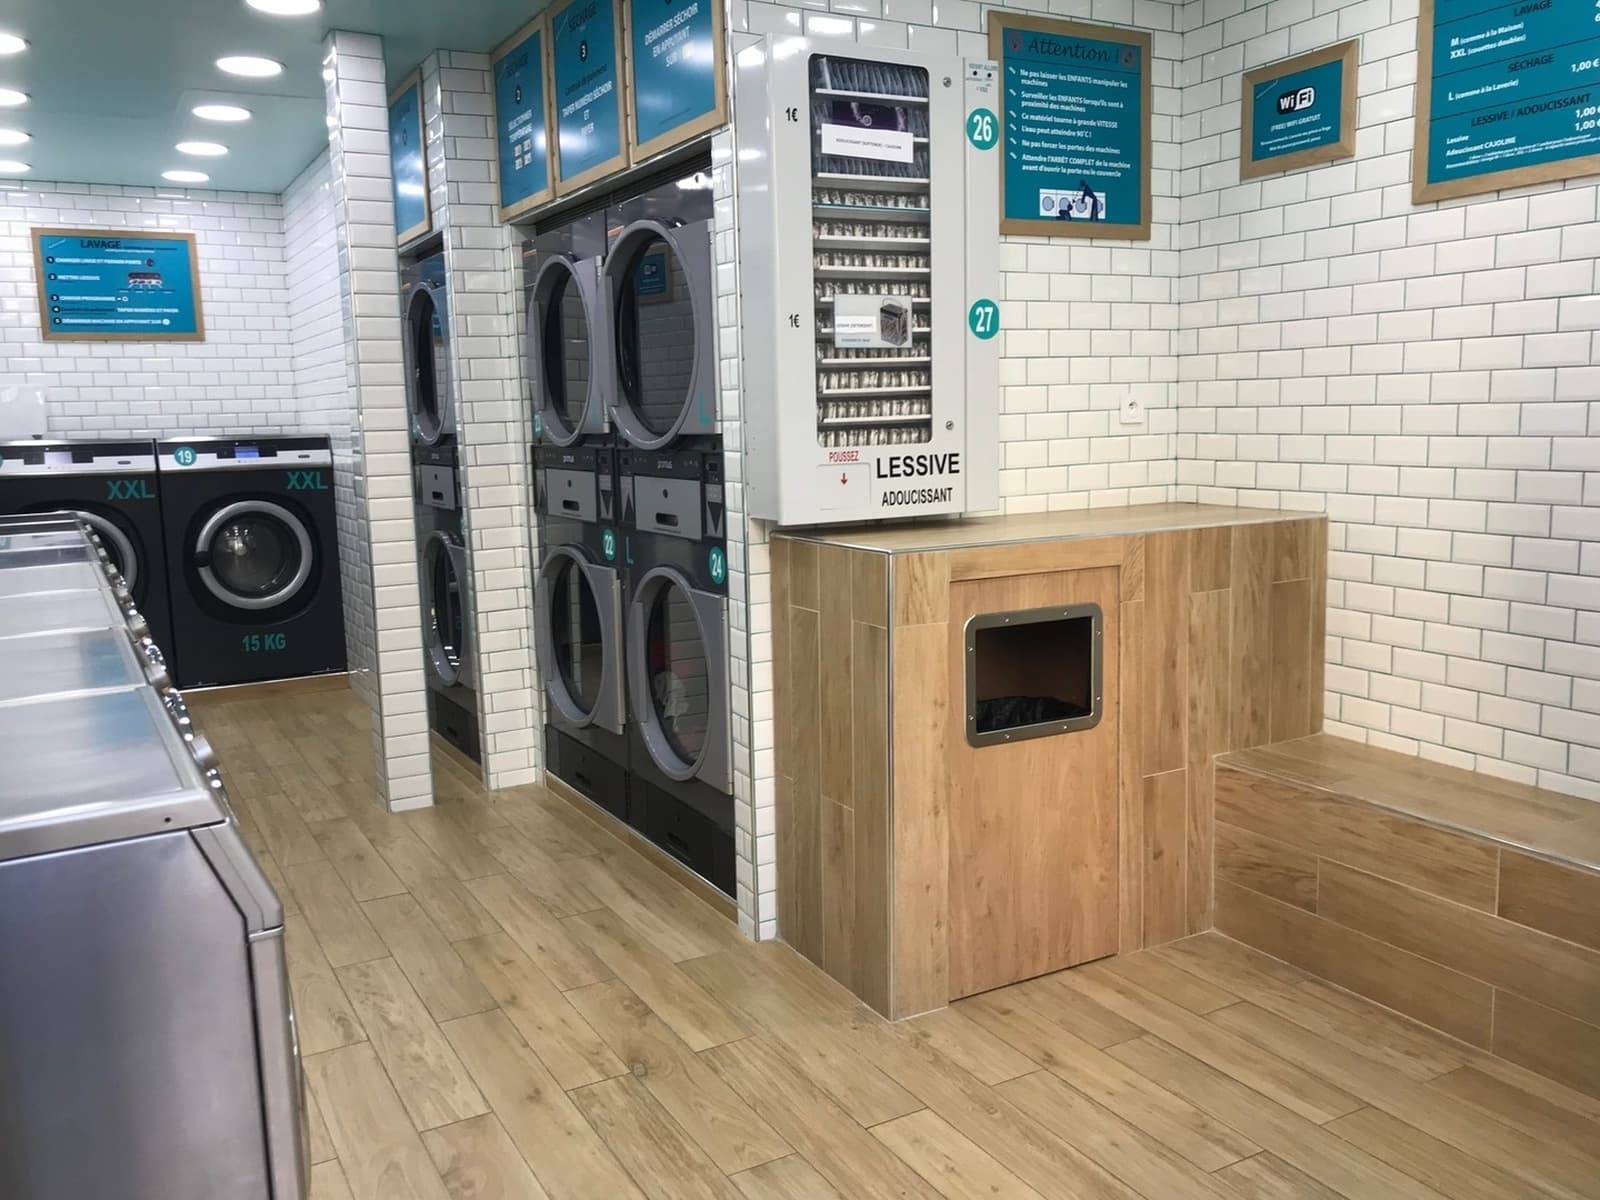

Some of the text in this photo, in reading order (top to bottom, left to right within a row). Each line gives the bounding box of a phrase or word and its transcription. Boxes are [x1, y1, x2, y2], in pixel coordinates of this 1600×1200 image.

[1513, 0, 1553, 17] LAVAGE
[1028, 37, 1110, 61] Attention
[1450, 37, 1459, 47] M
[1449, 48, 1467, 59] XXL
[1508, 53, 1555, 72] SECHAGE
[1570, 60, 1592, 72] 1,00
[1020, 69, 1028, 77] Ne
[1058, 73, 1067, 81] les
[1067, 74, 1093, 84] ENFANTS
[1021, 79, 1048, 87] machines
[1049, 93, 1057, 101] les
[1057, 94, 1083, 104] ENFANTS
[1448, 91, 1454, 101] L
[785, 107, 798, 122] 1€
[1049, 102, 1059, 110] des
[1060, 104, 1086, 112] machines
[1471, 111, 1510, 127] LESSIVE
[1516, 93, 1592, 116] ADOUCISSANT
[1575, 106, 1596, 118] 1,00
[973, 114, 992, 142] 26
[1037, 127, 1050, 135] peut
[1575, 119, 1595, 131] 1,00
[1058, 142, 1067, 150] les
[1069, 157, 1095, 166] COMPLET
[80, 240, 121, 249] LAVAGE
[788, 314, 800, 329] 1€
[975, 306, 993, 332] 27
[177, 450, 192, 464] 19
[829, 450, 859, 462] POUSSEZ
[876, 453, 960, 479] LESSIVE
[287, 471, 328, 489] XXL
[107, 480, 155, 499] XXL
[881, 487, 953, 506] ADOUCISSANT
[605, 534, 614, 556] 22
[626, 536, 634, 564] L
[711, 553, 722, 578] 24
[242, 633, 287, 651] 15 KG
